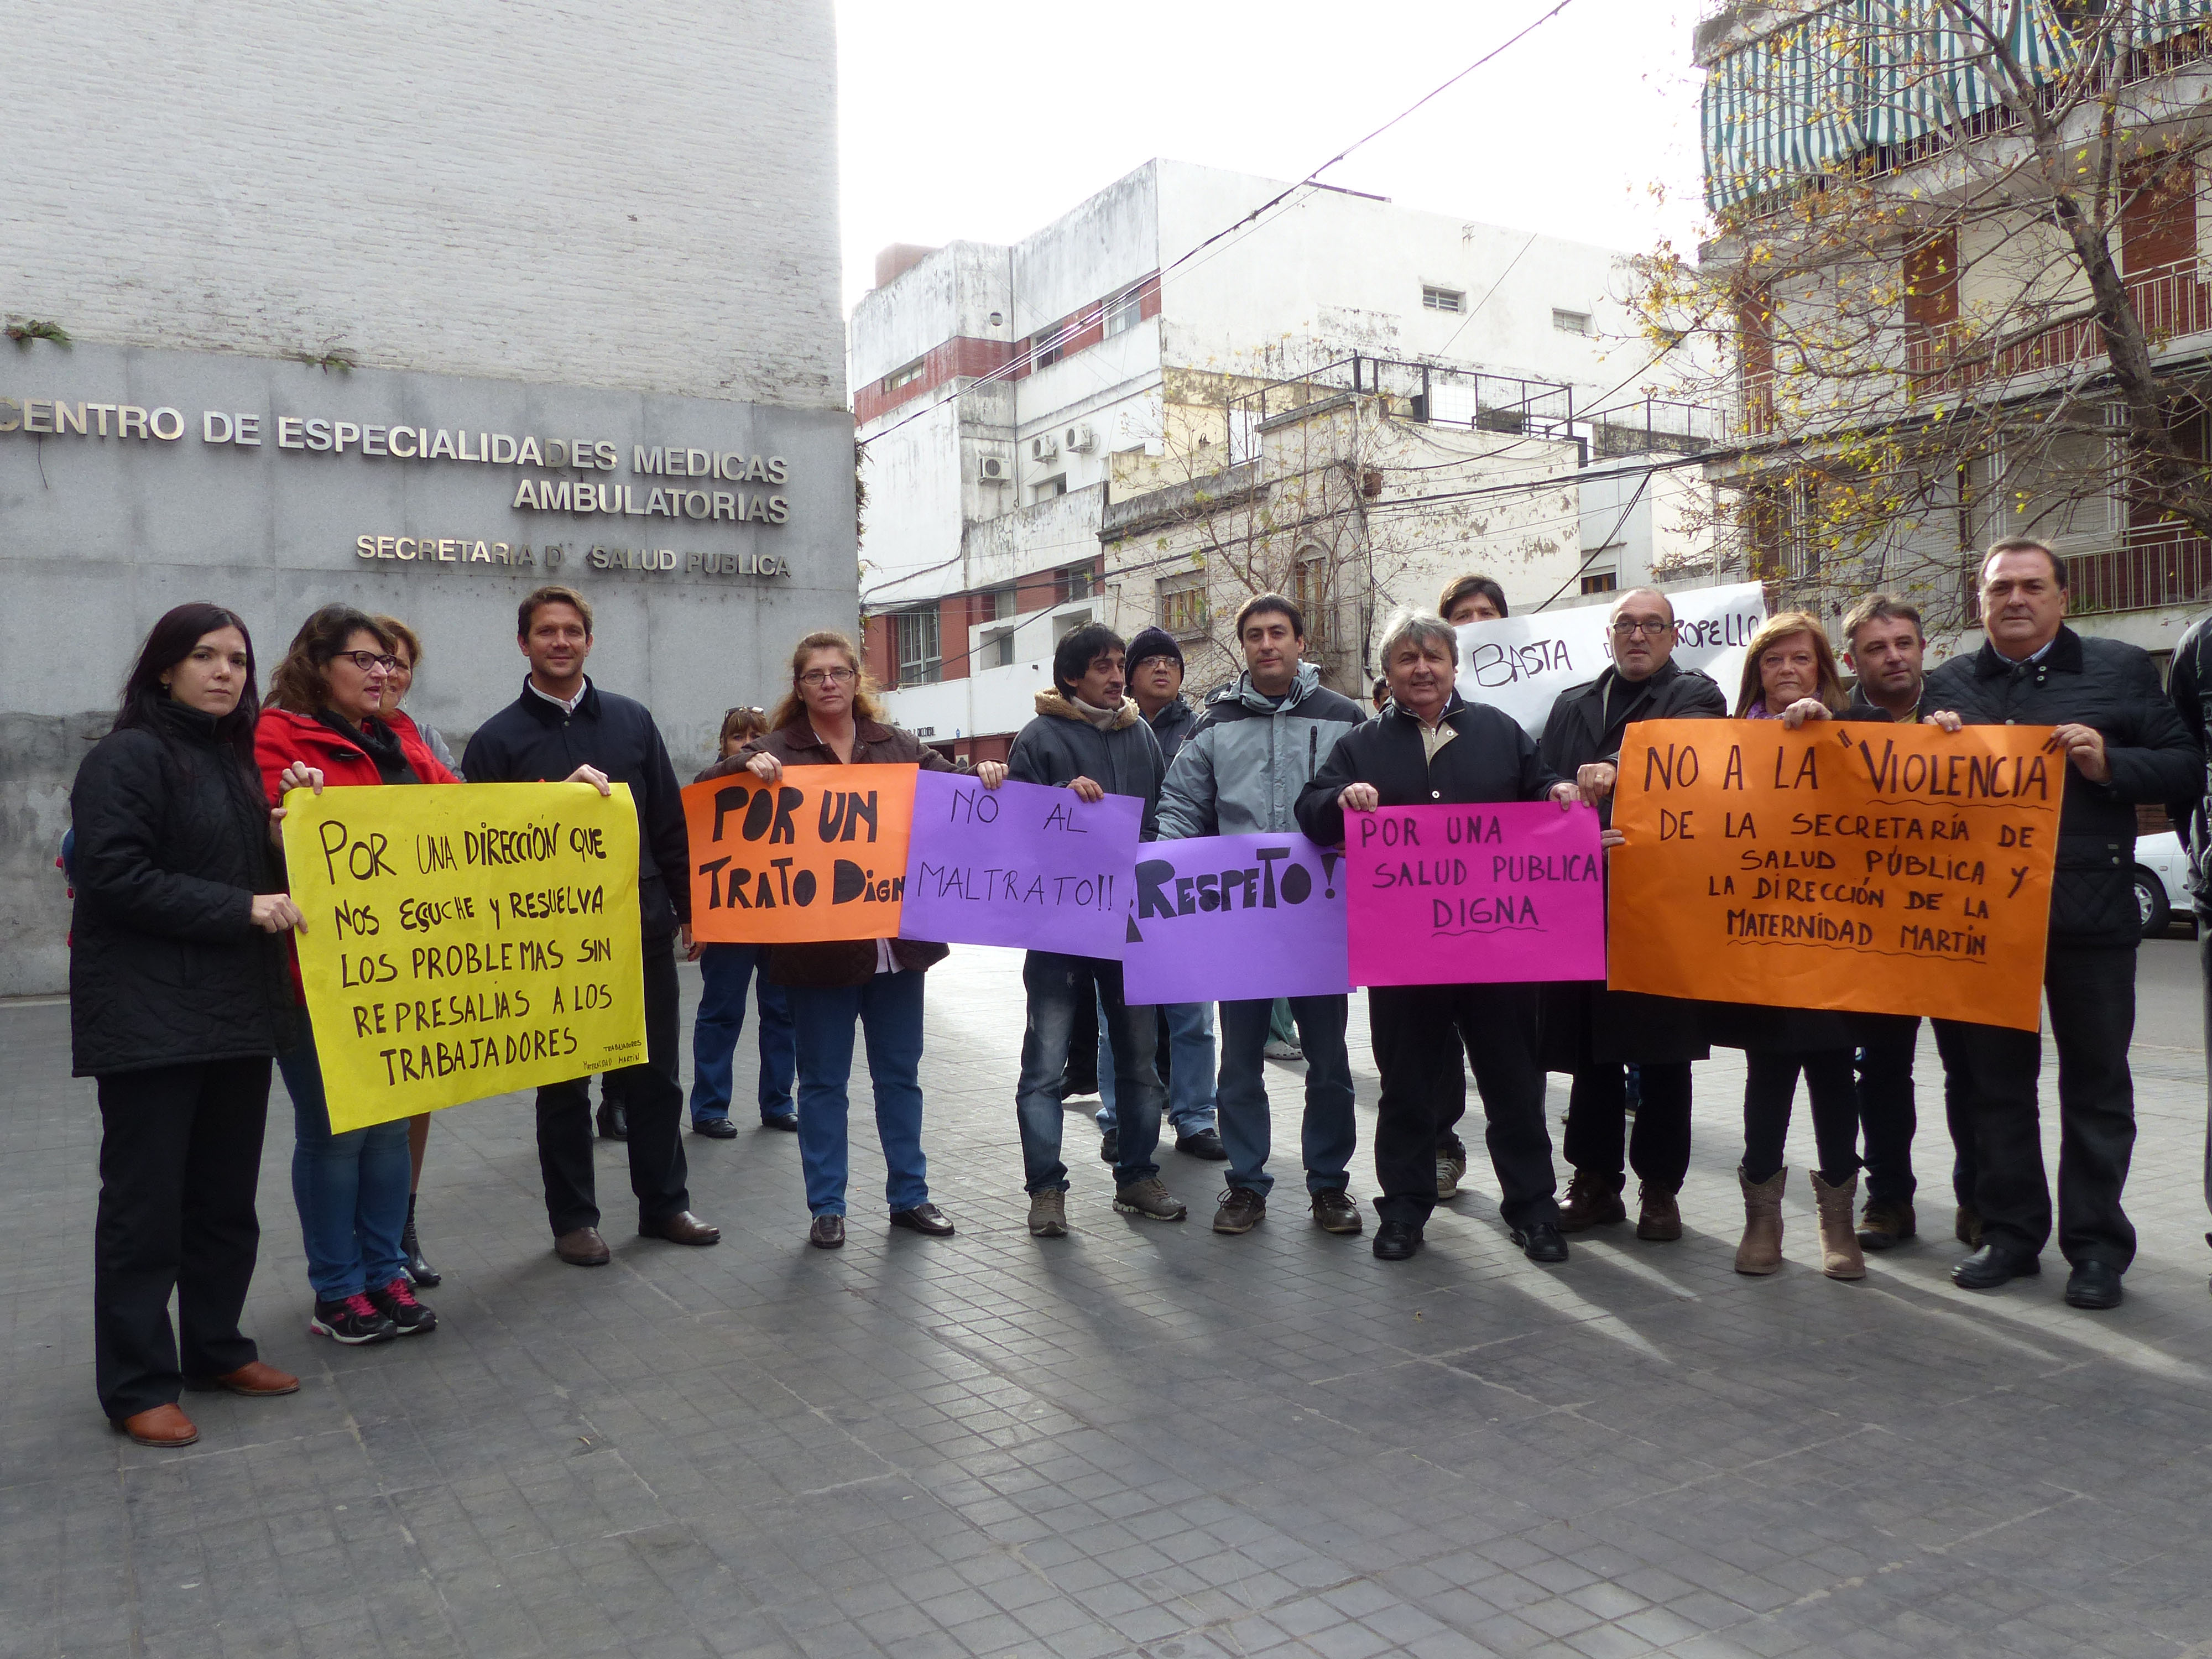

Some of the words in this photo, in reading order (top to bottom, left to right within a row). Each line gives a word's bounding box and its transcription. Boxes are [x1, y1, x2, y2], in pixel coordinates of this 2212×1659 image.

[0, 397, 185, 441] CENTRO
[202, 410, 262, 446] DE
[278, 416, 618, 472] ESPECIALIDADES
[633, 445, 789, 486] MEDICAS
[513, 479, 790, 524] AMBULATORIAS
[356, 534, 538, 566] SECRETARIA
[590, 544, 678, 571] SALUD
[685, 551, 791, 578] PUBLICA
[1473, 639, 1573, 687] BASTA
[1672, 613, 1759, 649] ROPELLO
[1644, 743, 1699, 792] NO
[1722, 744, 1744, 790] A
[1774, 746, 1818, 790] LA
[712, 786, 804, 845] POR
[818, 789, 878, 843] UN
[951, 789, 999, 823] NO
[1043, 802, 1088, 833] AL
[1361, 818, 1420, 848] POR
[1447, 816, 1503, 844] UNA
[1659, 808, 1694, 841] DE
[1725, 812, 1756, 839] LA
[1997, 825, 2035, 848] DE
[416, 833, 457, 874] UNA
[570, 827, 607, 863] QUE
[1372, 858, 1468, 888] SALUD
[1493, 854, 1599, 883] PUBLICA
[1740, 849, 1835, 871] SALUD
[2006, 865, 2030, 899] Y
[698, 855, 817, 910] TRATO
[917, 861, 1114, 912] MALTRATO!!
[1709, 875, 1734, 896] LA
[1904, 890, 1943, 911] DE
[1964, 897, 1989, 920] LA
[335, 899, 379, 940] NOS
[490, 898, 500, 930] Y
[509, 884, 604, 919] RESUELVA
[1433, 897, 1540, 928] DIGNA
[1726, 909, 1873, 946] MATERNIDAD
[341, 953, 398, 988] LOS
[413, 939, 564, 979] PROBLEMAS
[576, 937, 612, 963] SIN
[352, 980, 530, 1038] REPRESALIAS
[552, 985, 564, 1015] A
[575, 983, 612, 1011] LOS
[380, 1027, 578, 1086] TRABAJADORES
[603, 1040, 642, 1052] TRABAJADORES
